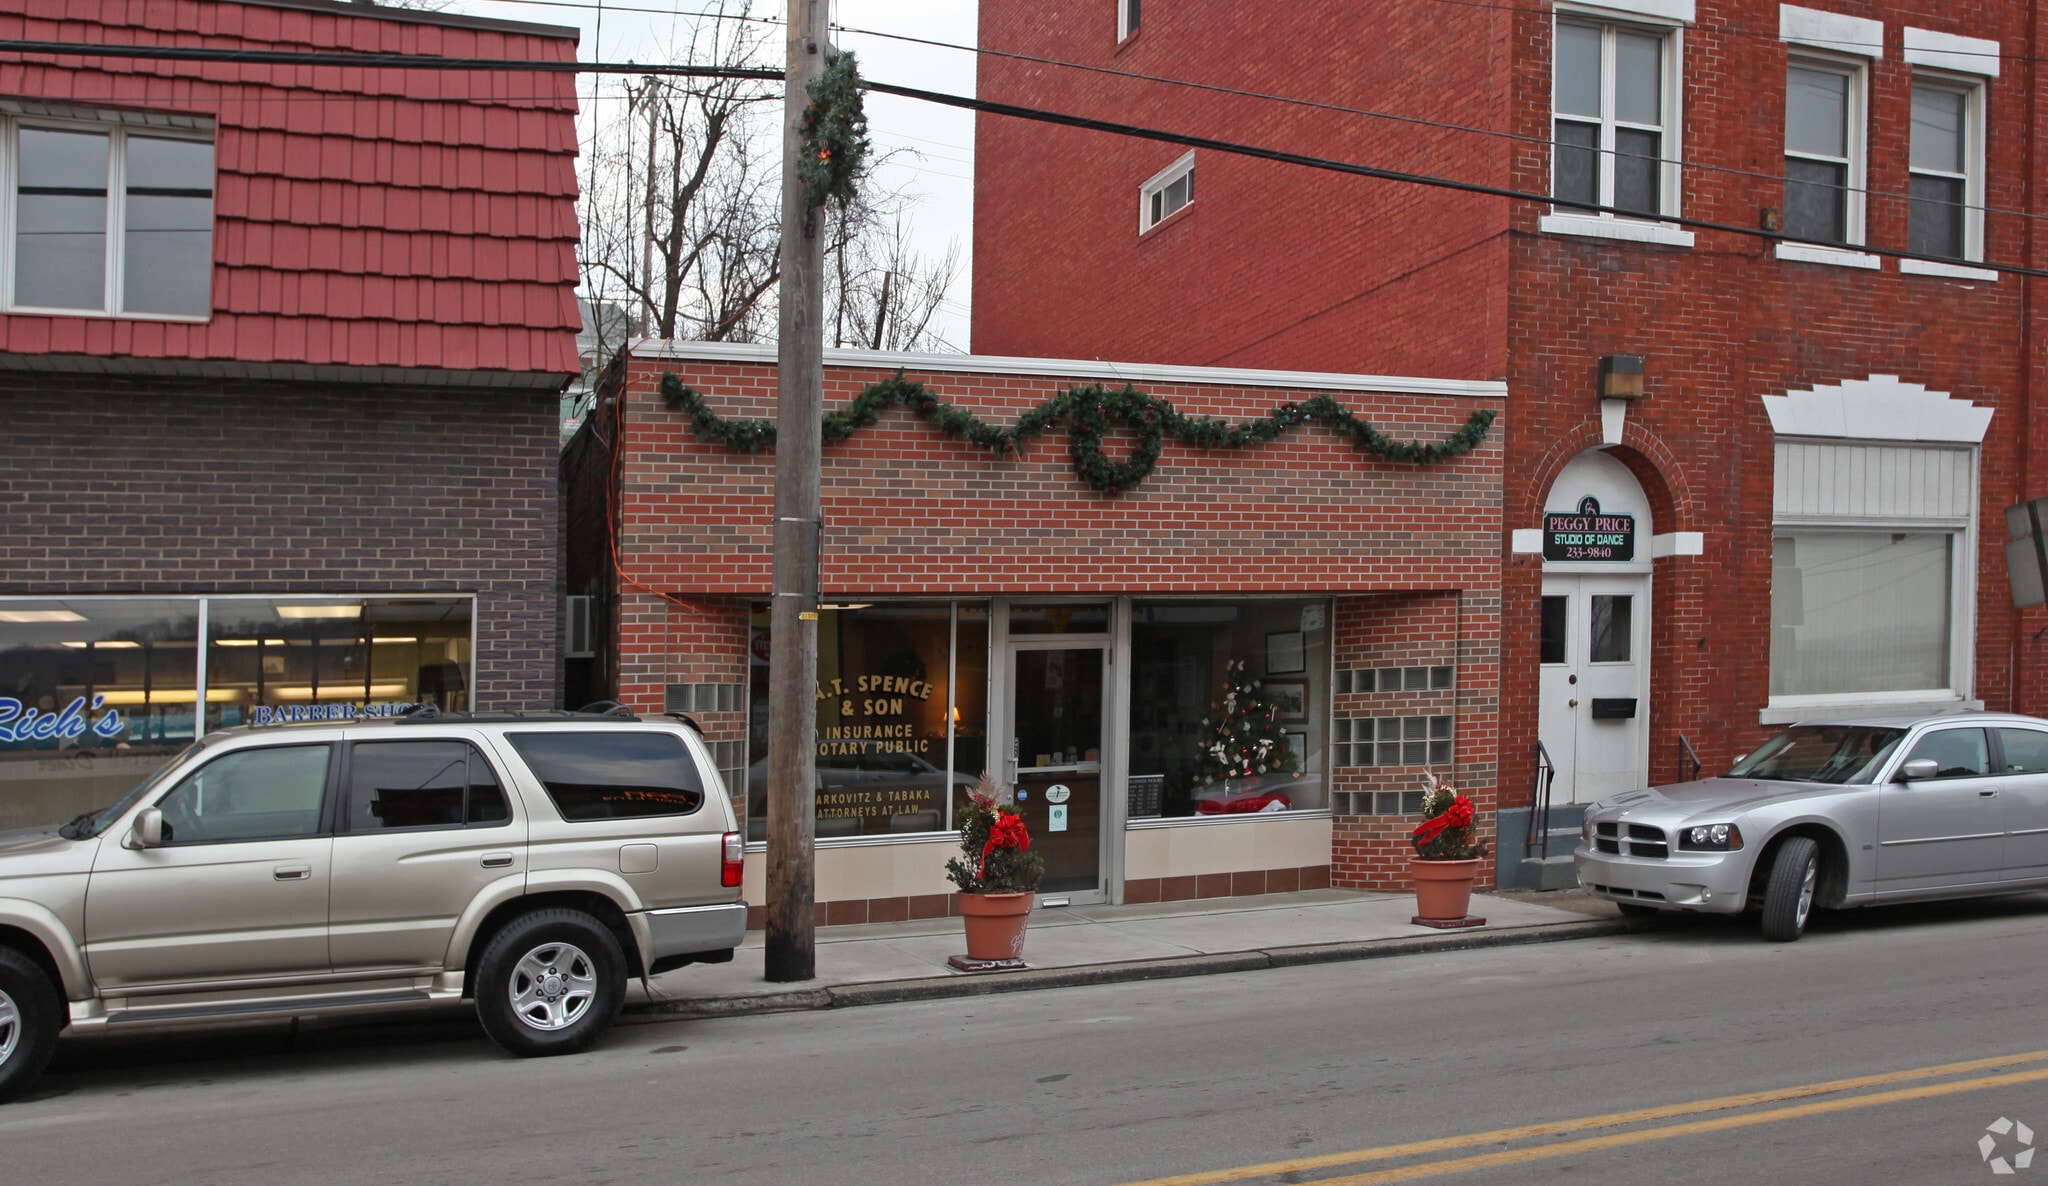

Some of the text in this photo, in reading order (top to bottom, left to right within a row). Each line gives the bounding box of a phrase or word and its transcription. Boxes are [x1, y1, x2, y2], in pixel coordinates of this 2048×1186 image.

[1549, 517, 1630, 531] PEGGY PRICE
[1554, 533, 1624, 545] STUDIO OF DANCE
[1566, 547, 1612, 559] 233-9840
[858, 675, 933, 700] SPENCE
[255, 703, 413, 724] BARBER SHO
[841, 698, 903, 716] & SON
[0, 694, 124, 742] Rich's
[826, 724, 912, 739] INSURANCE
[815, 740, 929, 756] OTARY PUBLIC
[816, 790, 930, 805] ARKOVITZ & TABAKA
[817, 804, 919, 819] ATTORNEYS AT LAW
